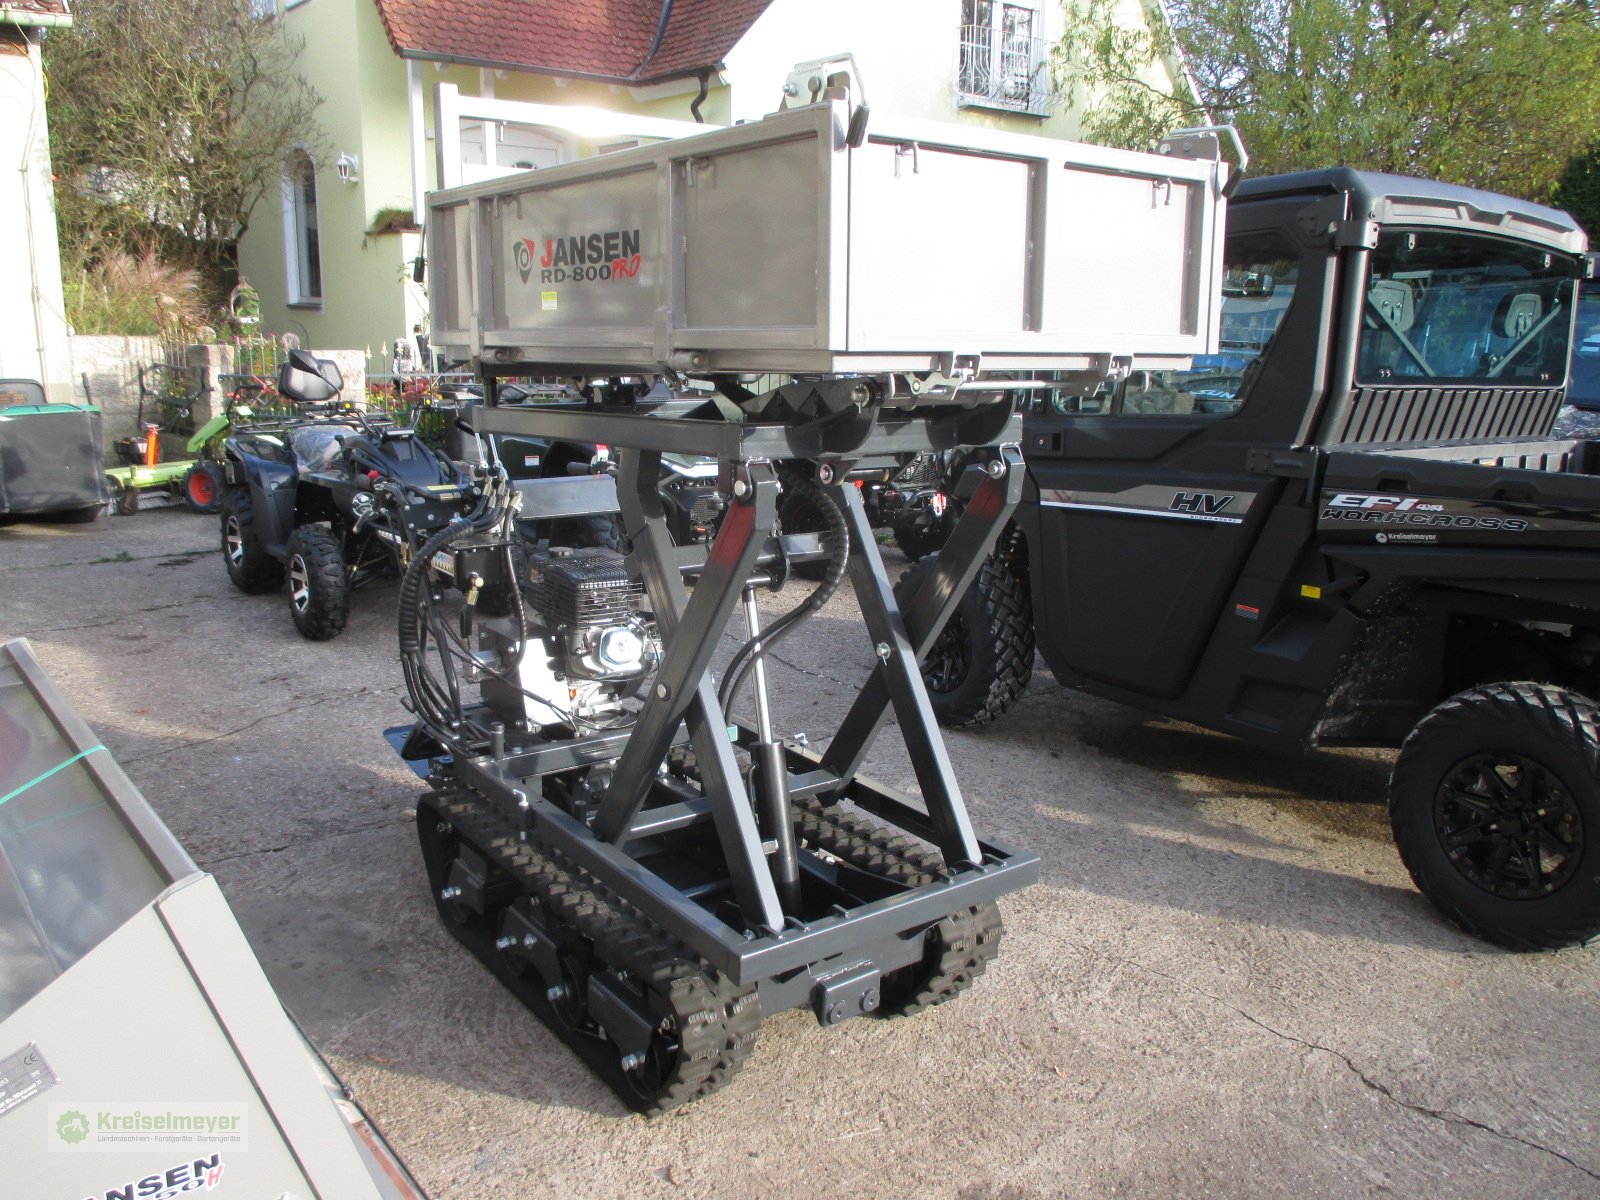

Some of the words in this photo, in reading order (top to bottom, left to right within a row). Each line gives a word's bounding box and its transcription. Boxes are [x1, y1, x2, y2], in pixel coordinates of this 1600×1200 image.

[541, 229, 640, 268] JANSEN
[1168, 491, 1234, 514] HV
[1320, 508, 1529, 532] WORKCROSS
[1388, 532, 1437, 541] Kreiselmeyer
